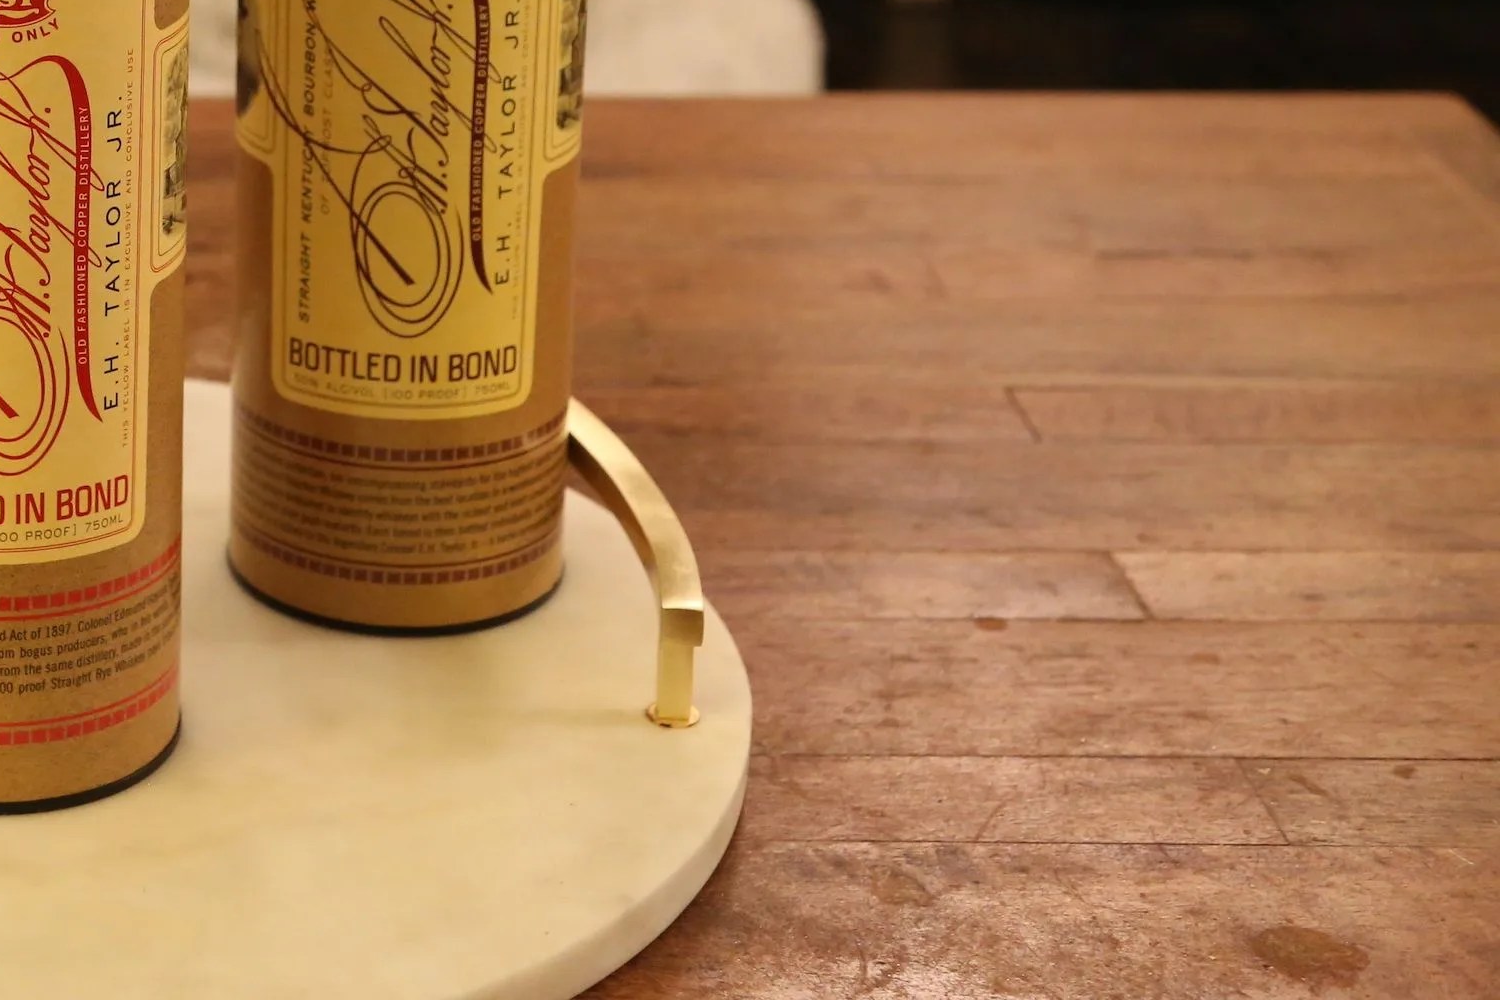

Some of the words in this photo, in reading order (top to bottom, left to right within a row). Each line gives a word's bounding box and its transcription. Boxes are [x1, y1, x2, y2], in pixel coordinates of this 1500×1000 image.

[11, 17, 60, 44] ONLY
[477, 4, 491, 78] DISTILLERY
[303, 22, 317, 117] BOURBON
[105, 95, 123, 153] JR.
[126, 80, 134, 163] CONCLUSIVE
[474, 83, 487, 135] COPPER
[498, 74, 518, 200] TAYLOR
[78, 106, 91, 186] DISTILLERY
[301, 125, 314, 224] KENTUY
[125, 169, 133, 195] AND
[472, 139, 483, 213] FASHIONED
[77, 191, 89, 248] COPPER
[104, 178, 122, 317] TAYLOR
[124, 204, 132, 271] EXCLUSIVE
[298, 232, 312, 325] STRAIGHT
[495, 221, 513, 286] E.H.
[76, 253, 88, 333] FASHIONED
[124, 278, 131, 292] IN
[77, 336, 88, 366] OLD
[123, 319, 131, 358] LABEL
[289, 336, 402, 384] BOTTLED
[409, 354, 439, 385] IN
[448, 345, 518, 383] BOND
[103, 340, 120, 412] E.H.
[122, 366, 130, 413] YELLOW
[14, 491, 46, 525] IN
[55, 473, 130, 521] BOND
[84, 513, 125, 533] 750ML
[9, 629, 28, 641] Act
[30, 626, 42, 640] of
[77, 612, 113, 634] Colonel
[20, 645, 53, 660] bogus
[18, 680, 47, 696] proof
[50, 669, 93, 691] Straight
[24, 663, 42, 675] the
[45, 659, 74, 674] same
